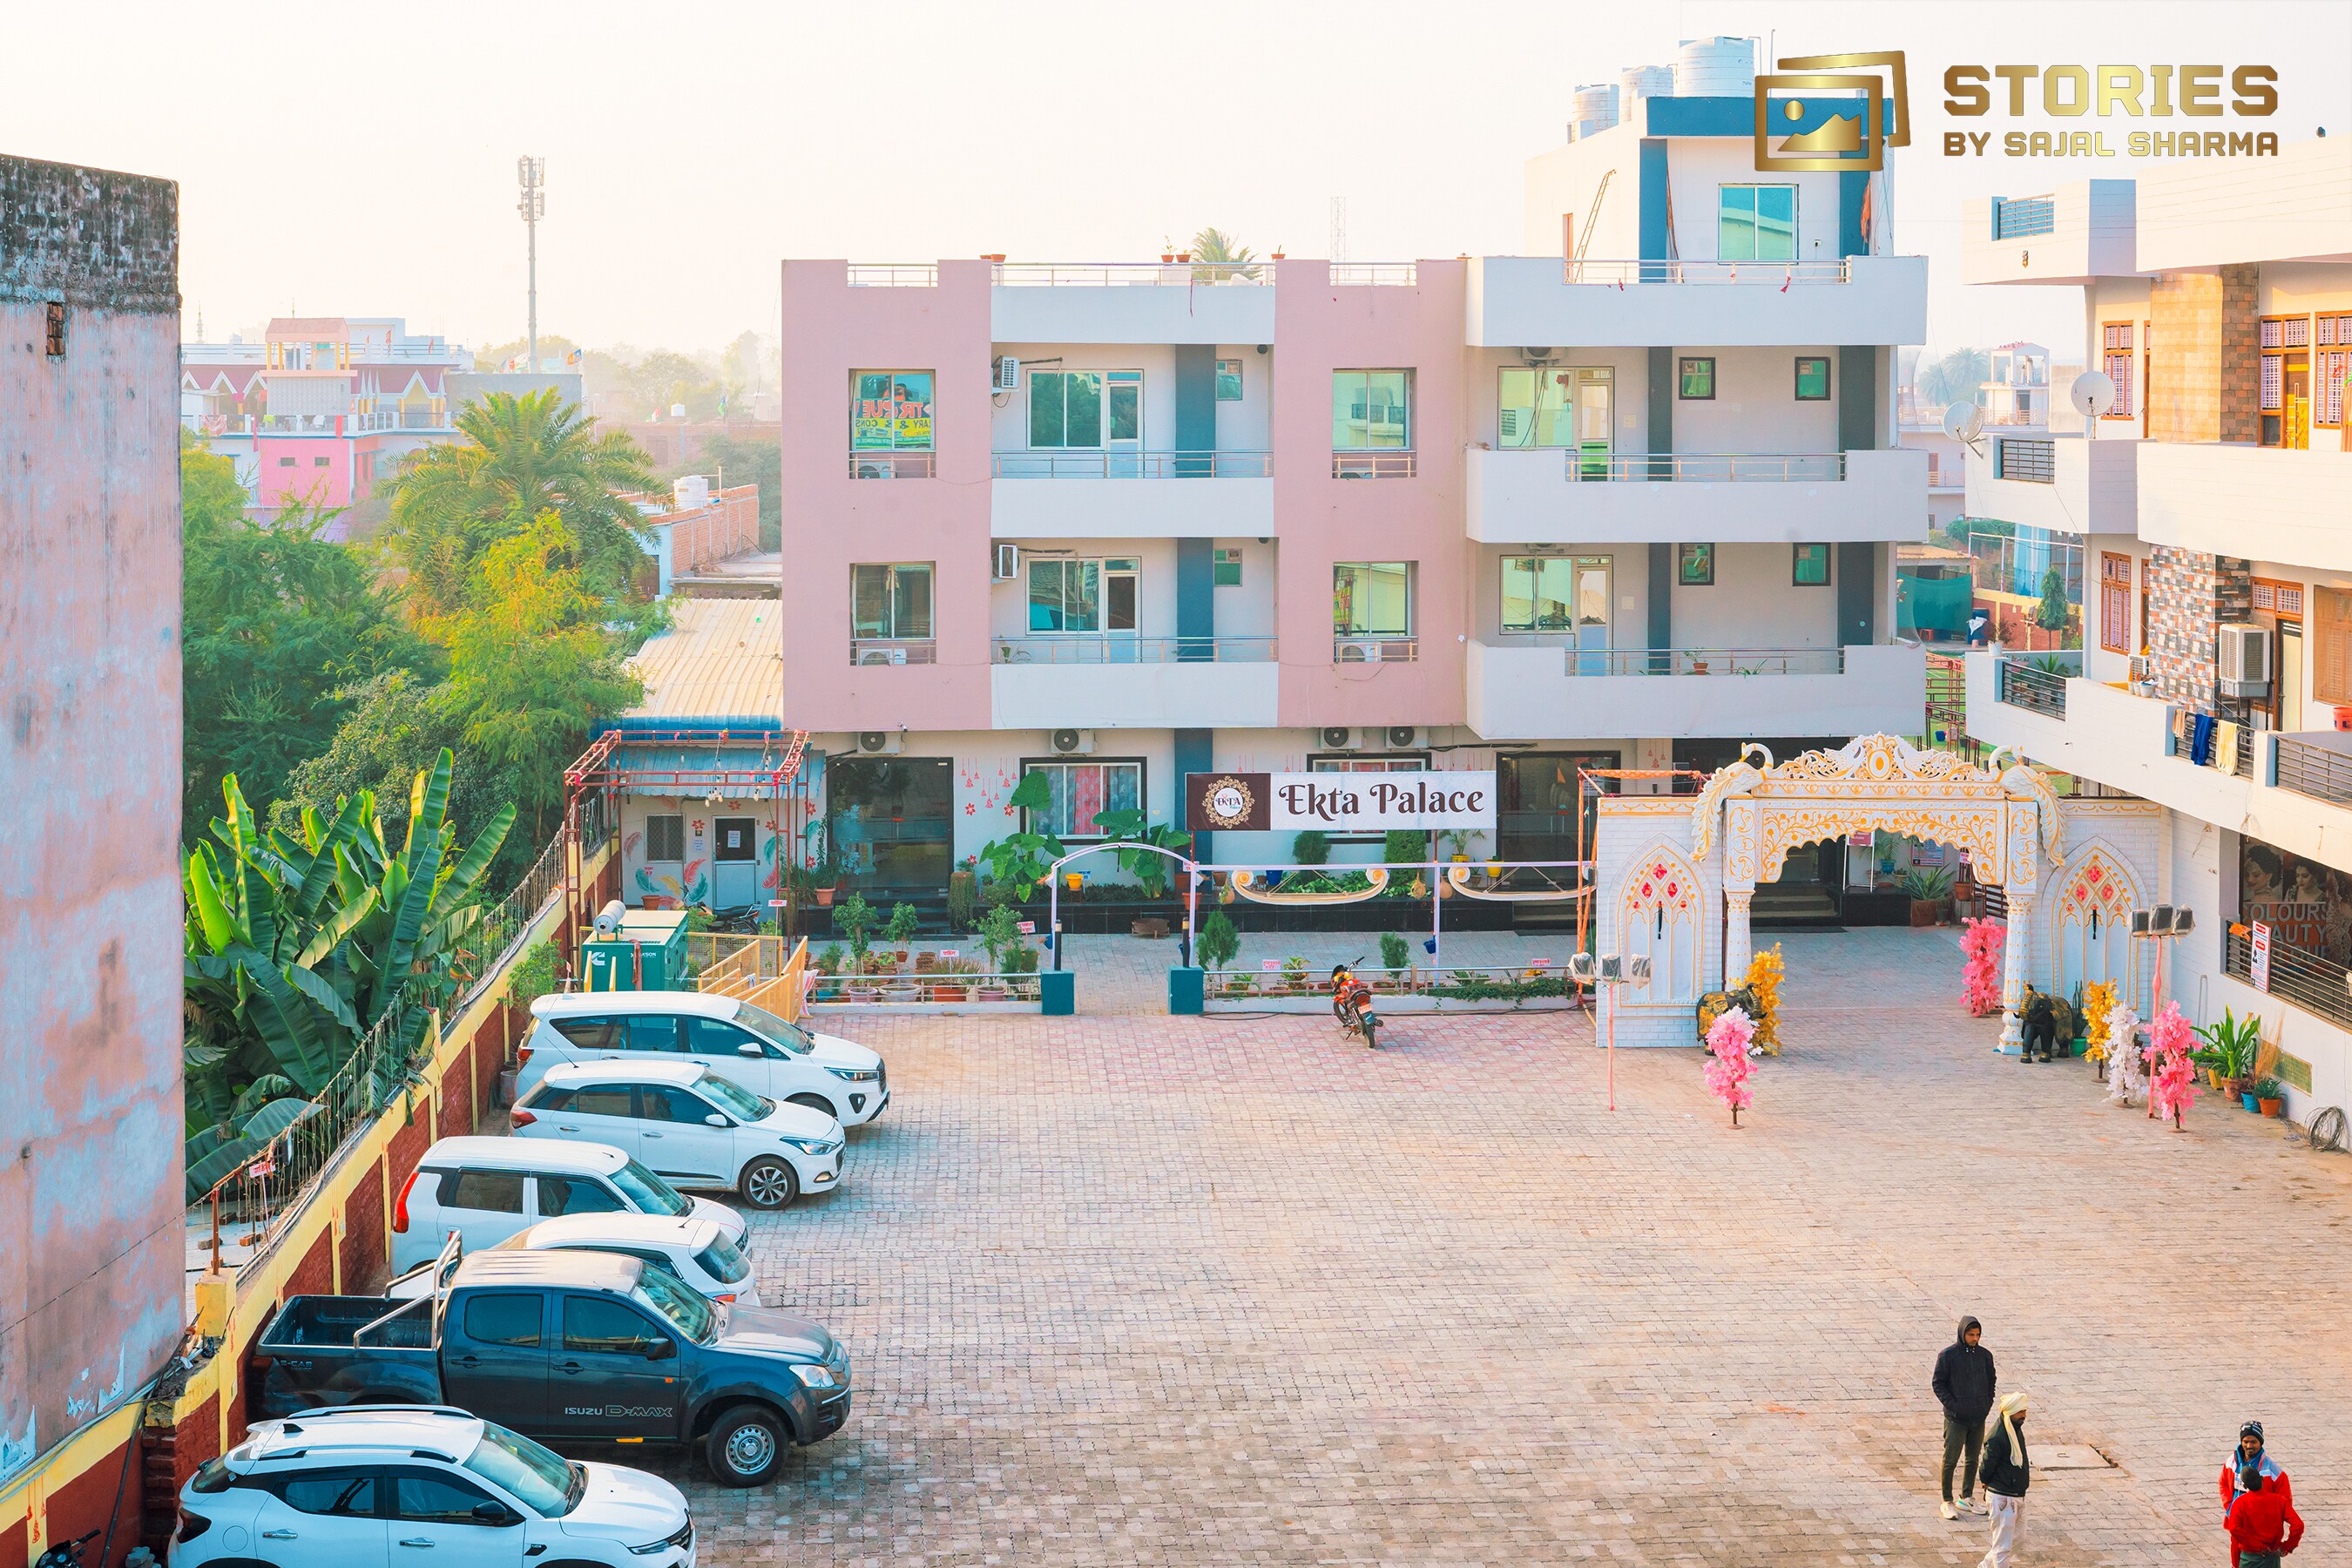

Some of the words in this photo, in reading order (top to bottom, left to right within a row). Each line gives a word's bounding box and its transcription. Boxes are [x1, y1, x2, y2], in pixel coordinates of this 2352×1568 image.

[1278, 783, 1361, 821] Ekta
[1369, 781, 1484, 814] Palace
[564, 1407, 603, 1416] ISUZU
[605, 1405, 673, 1417] D-MAX
